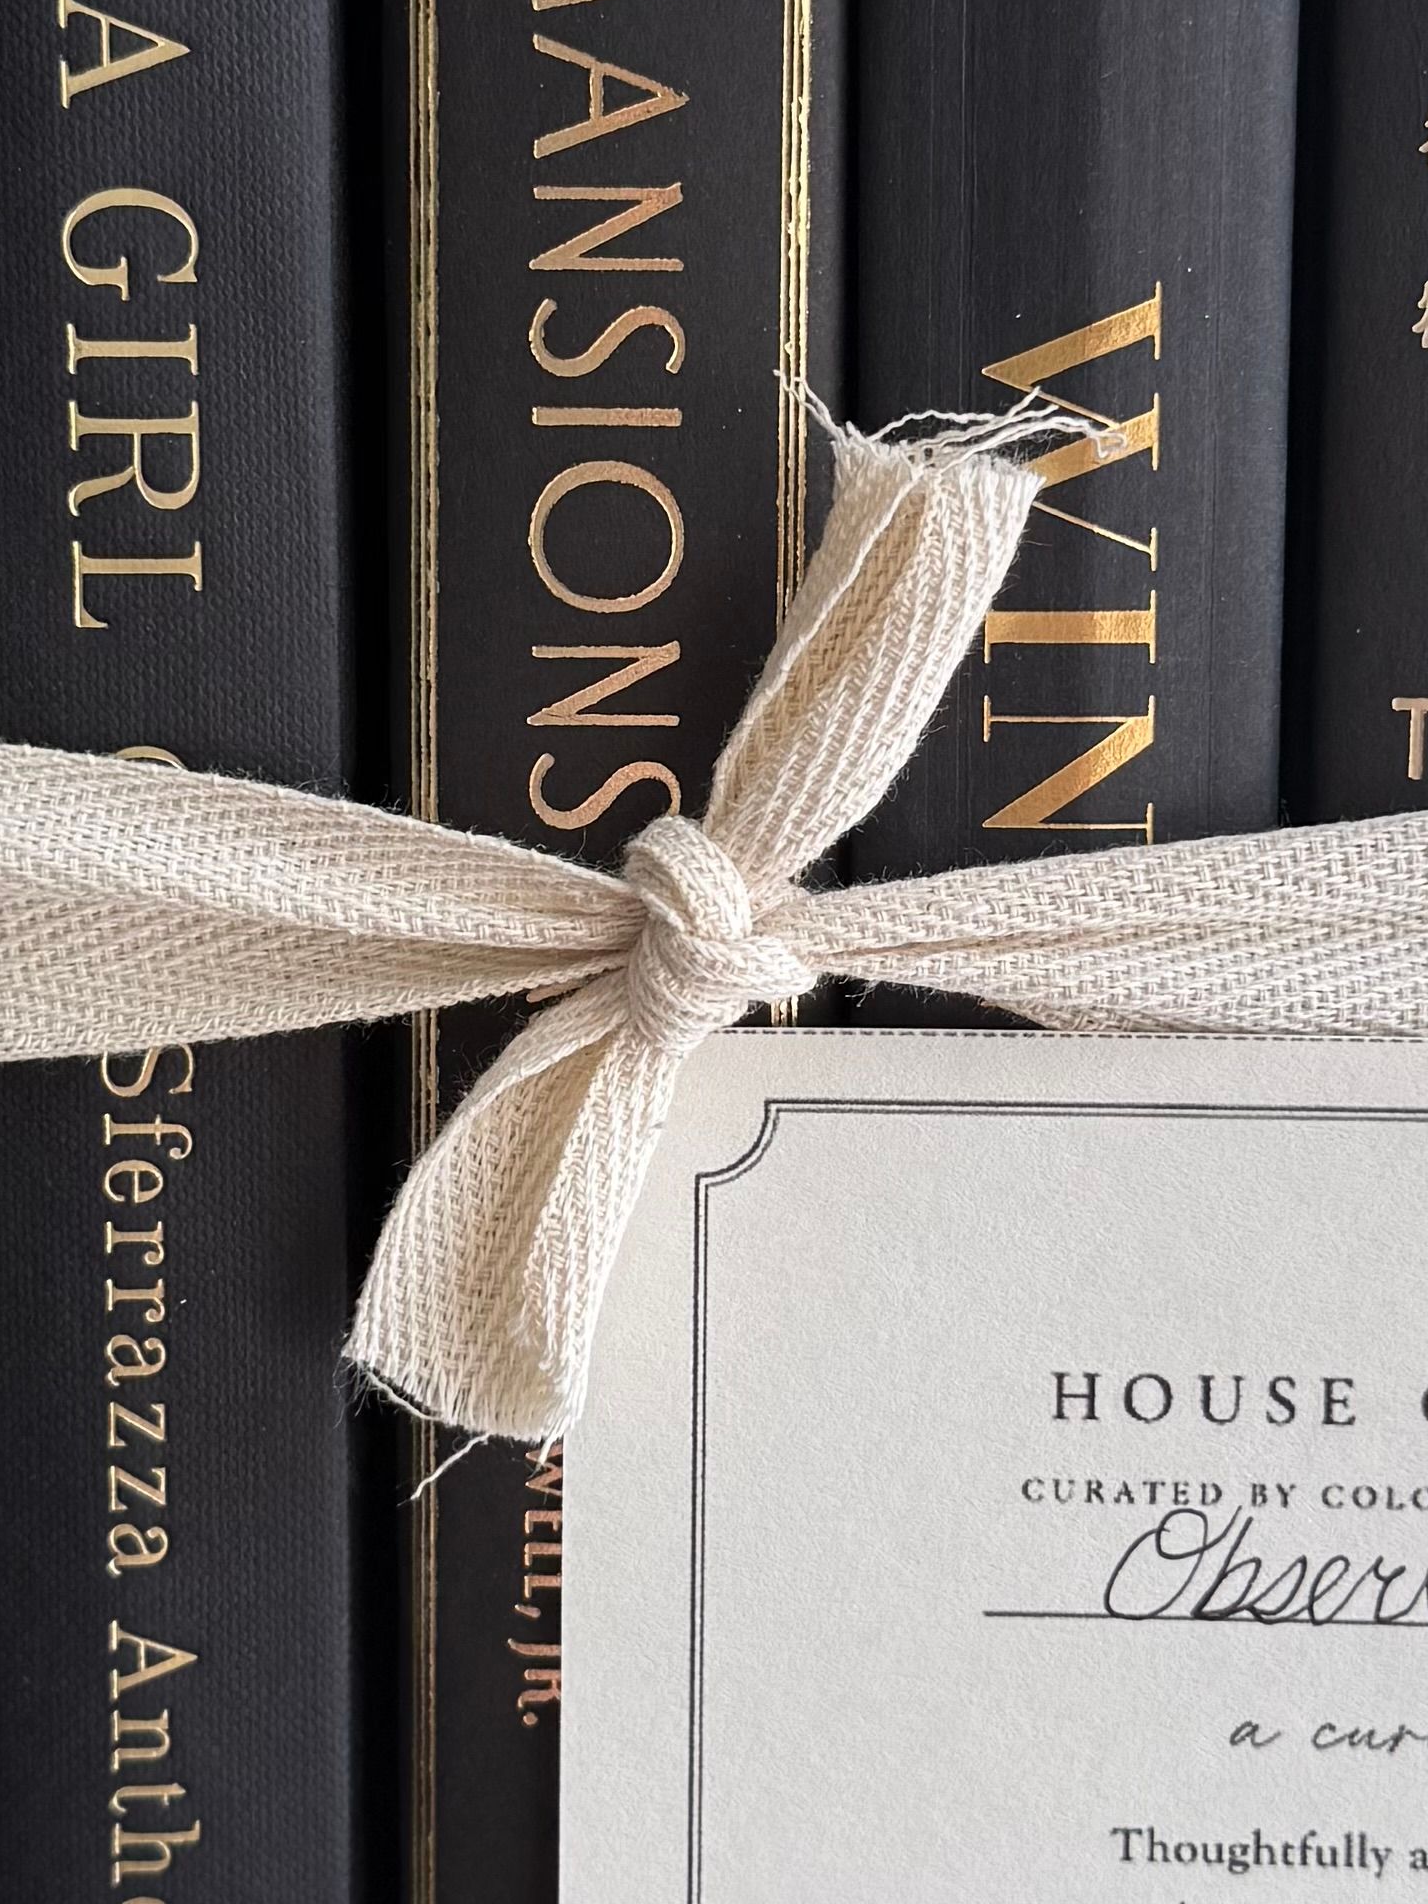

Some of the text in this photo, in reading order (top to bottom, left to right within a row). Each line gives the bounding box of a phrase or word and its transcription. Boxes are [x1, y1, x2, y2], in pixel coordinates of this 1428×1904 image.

[61, 187, 203, 628] GIRL
[102, 1040, 195, 1579] Sferrazza
[1052, 1371, 1356, 1427] HOUSE
[1021, 1478, 1223, 1506] CURATED
[1251, 1483, 1296, 1509] BY
[1229, 1720, 1282, 1749] a
[1110, 1826, 1393, 1879] Thoughtfully
